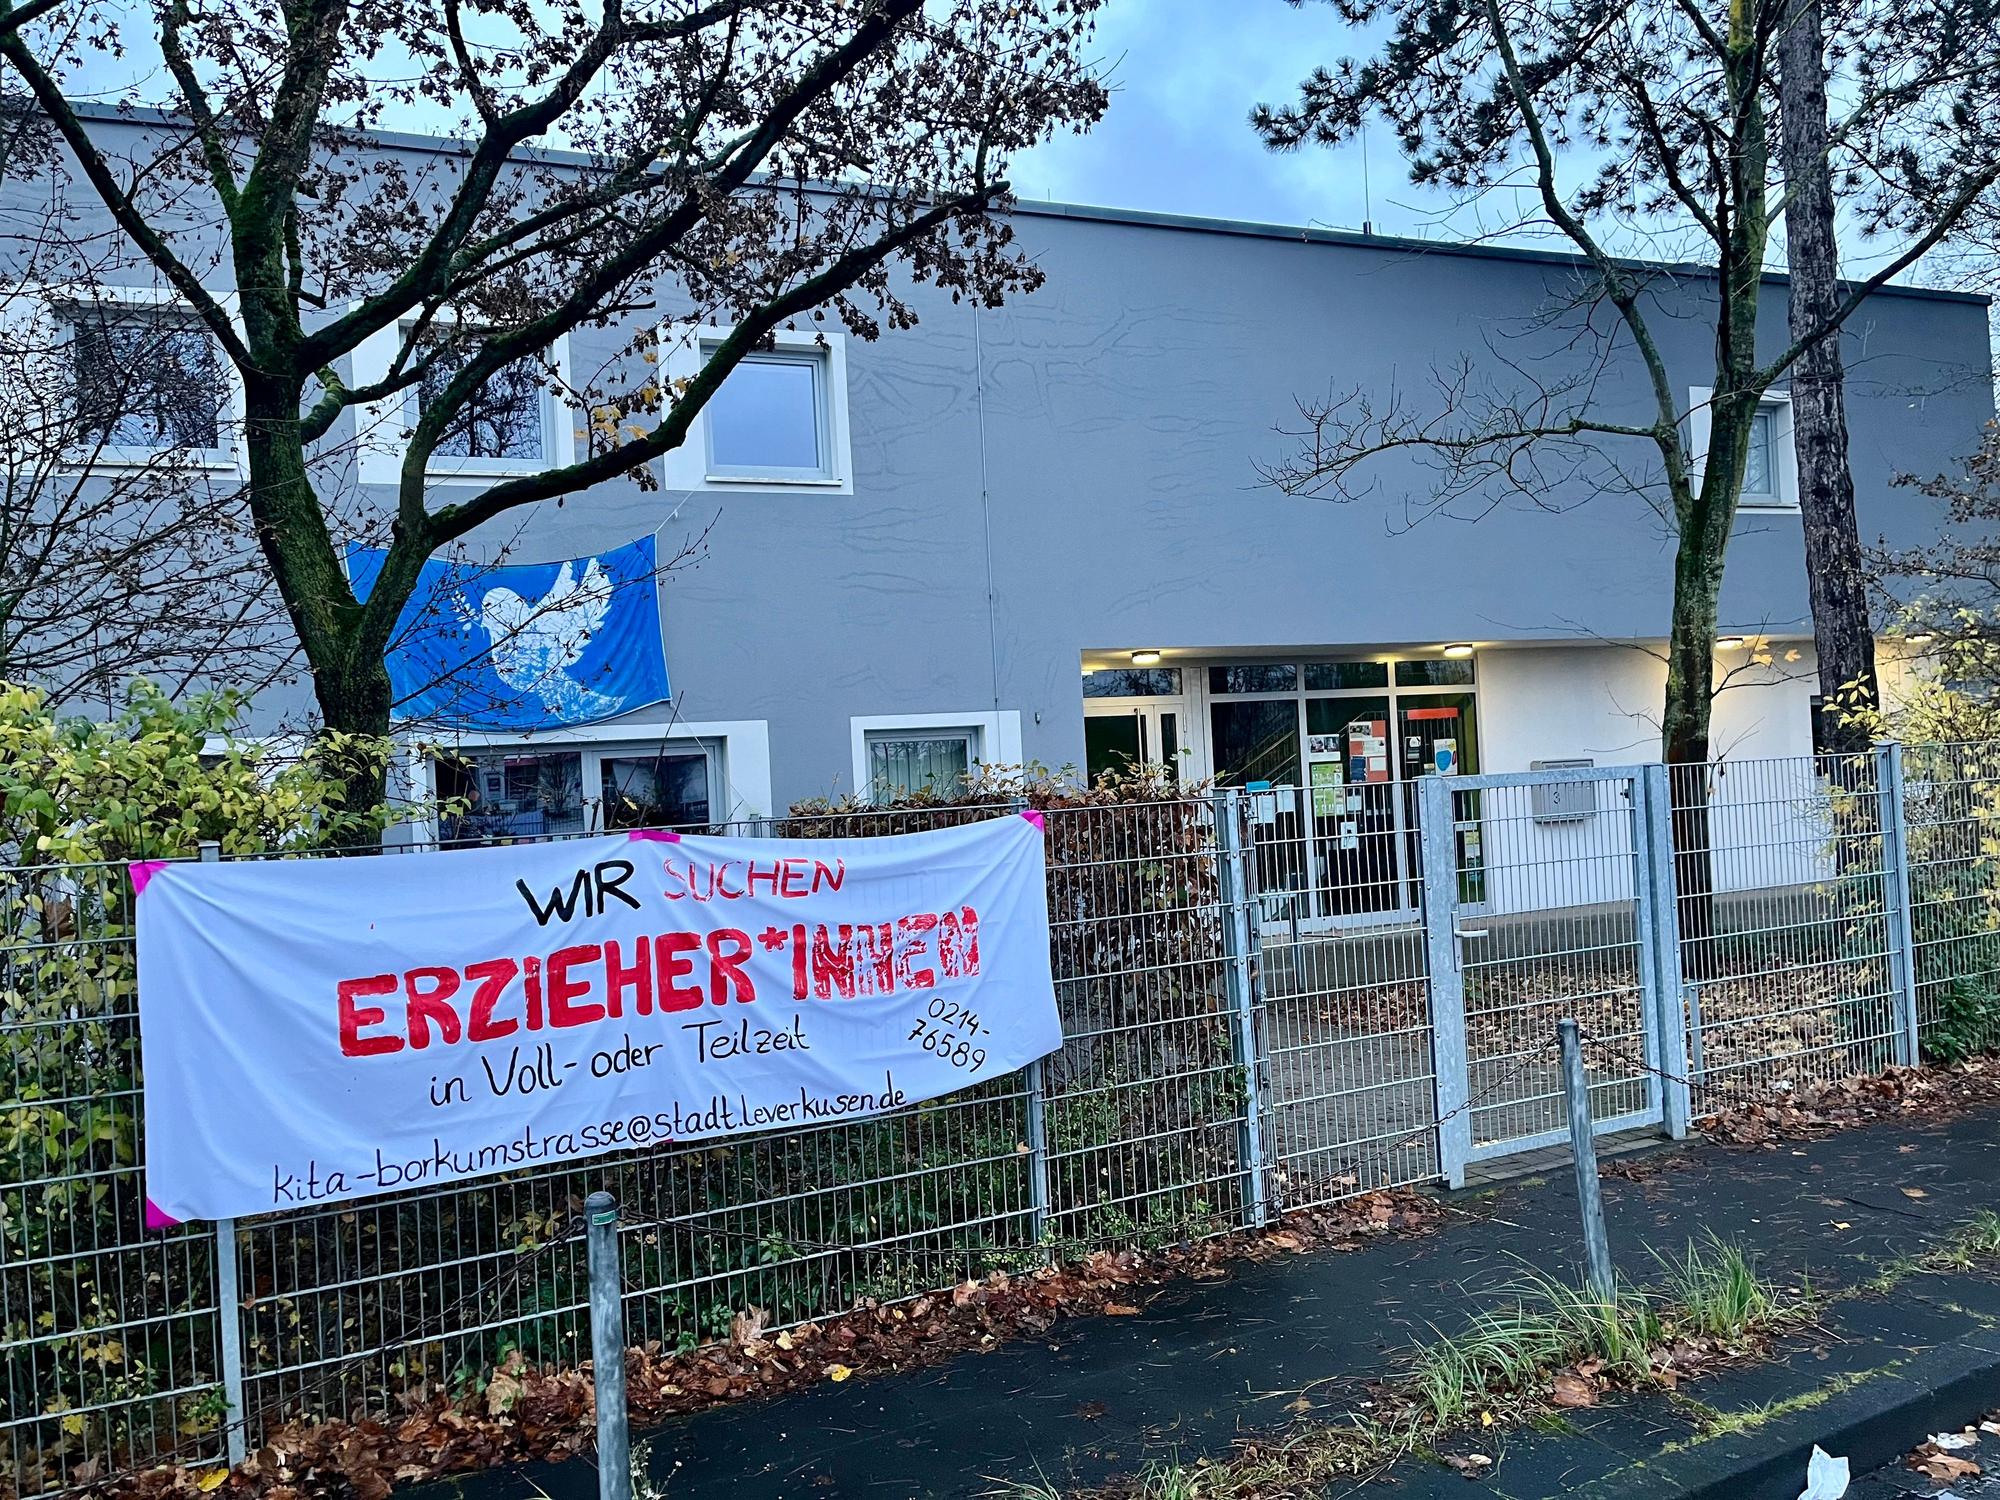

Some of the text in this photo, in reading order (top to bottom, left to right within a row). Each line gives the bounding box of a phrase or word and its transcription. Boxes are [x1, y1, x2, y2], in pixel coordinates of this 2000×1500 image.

[516, 858, 846, 926] WIR SUCHEN
[908, 1018, 987, 1073] 76589
[928, 998, 990, 1037] 0214-
[430, 1014, 810, 1106] in Voll- oder Teilzeit
[274, 1070, 907, 1203] kita-borkumstrasse@stadt.leverkusen.de
